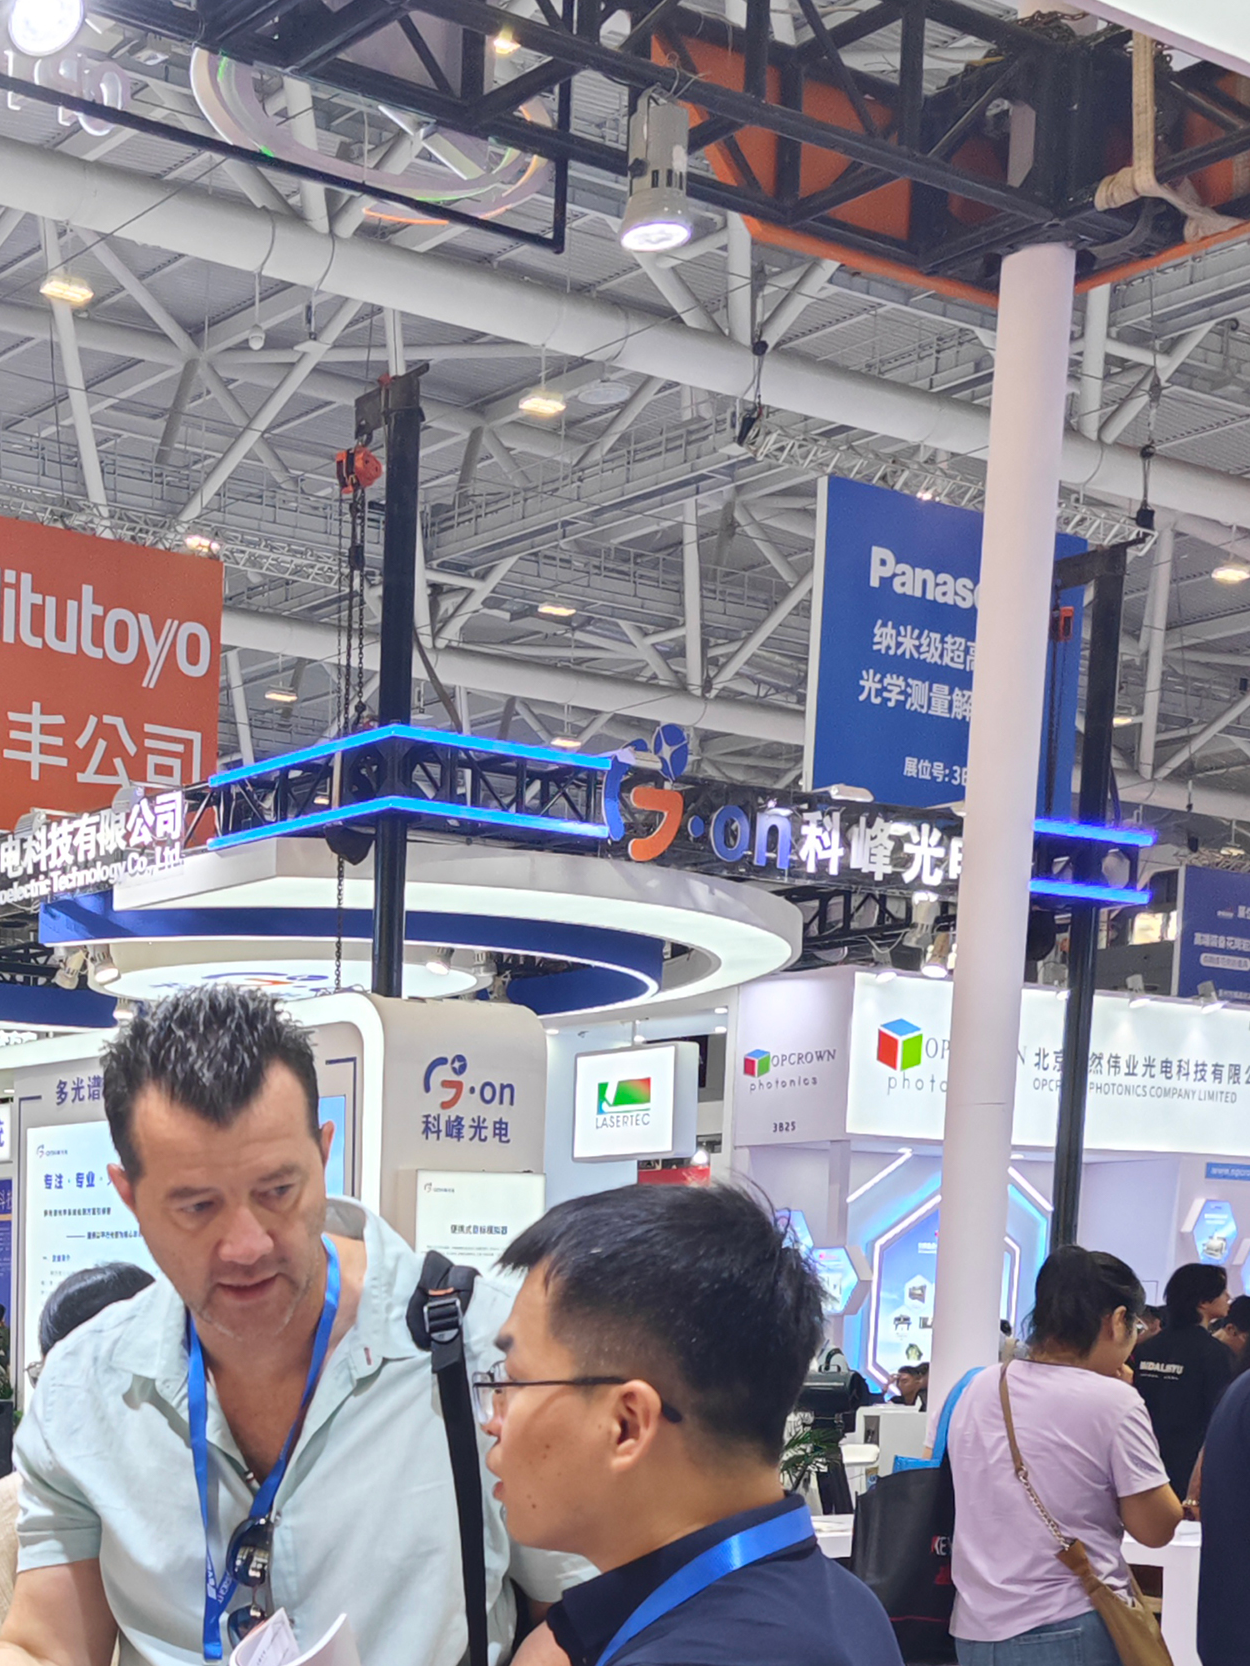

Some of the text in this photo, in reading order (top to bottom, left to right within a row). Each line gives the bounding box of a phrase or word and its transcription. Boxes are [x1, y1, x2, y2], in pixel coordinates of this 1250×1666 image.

[50, 859, 127, 894] Technology
[771, 1048, 837, 1067] OPCROWN
[1034, 1046, 1250, 1086] 北京然伟业光电科技有限
[750, 1075, 818, 1094] photonics
[887, 1071, 948, 1095] photo
[1089, 1083, 1147, 1098] PHOTONICS
[1149, 1086, 1197, 1100] COMPANY
[1198, 1089, 1237, 1104] LIMITED
[421, 1113, 511, 1144] 科峰光电
[595, 1112, 651, 1129] LASERTEC
[772, 1121, 796, 1132] 3B25
